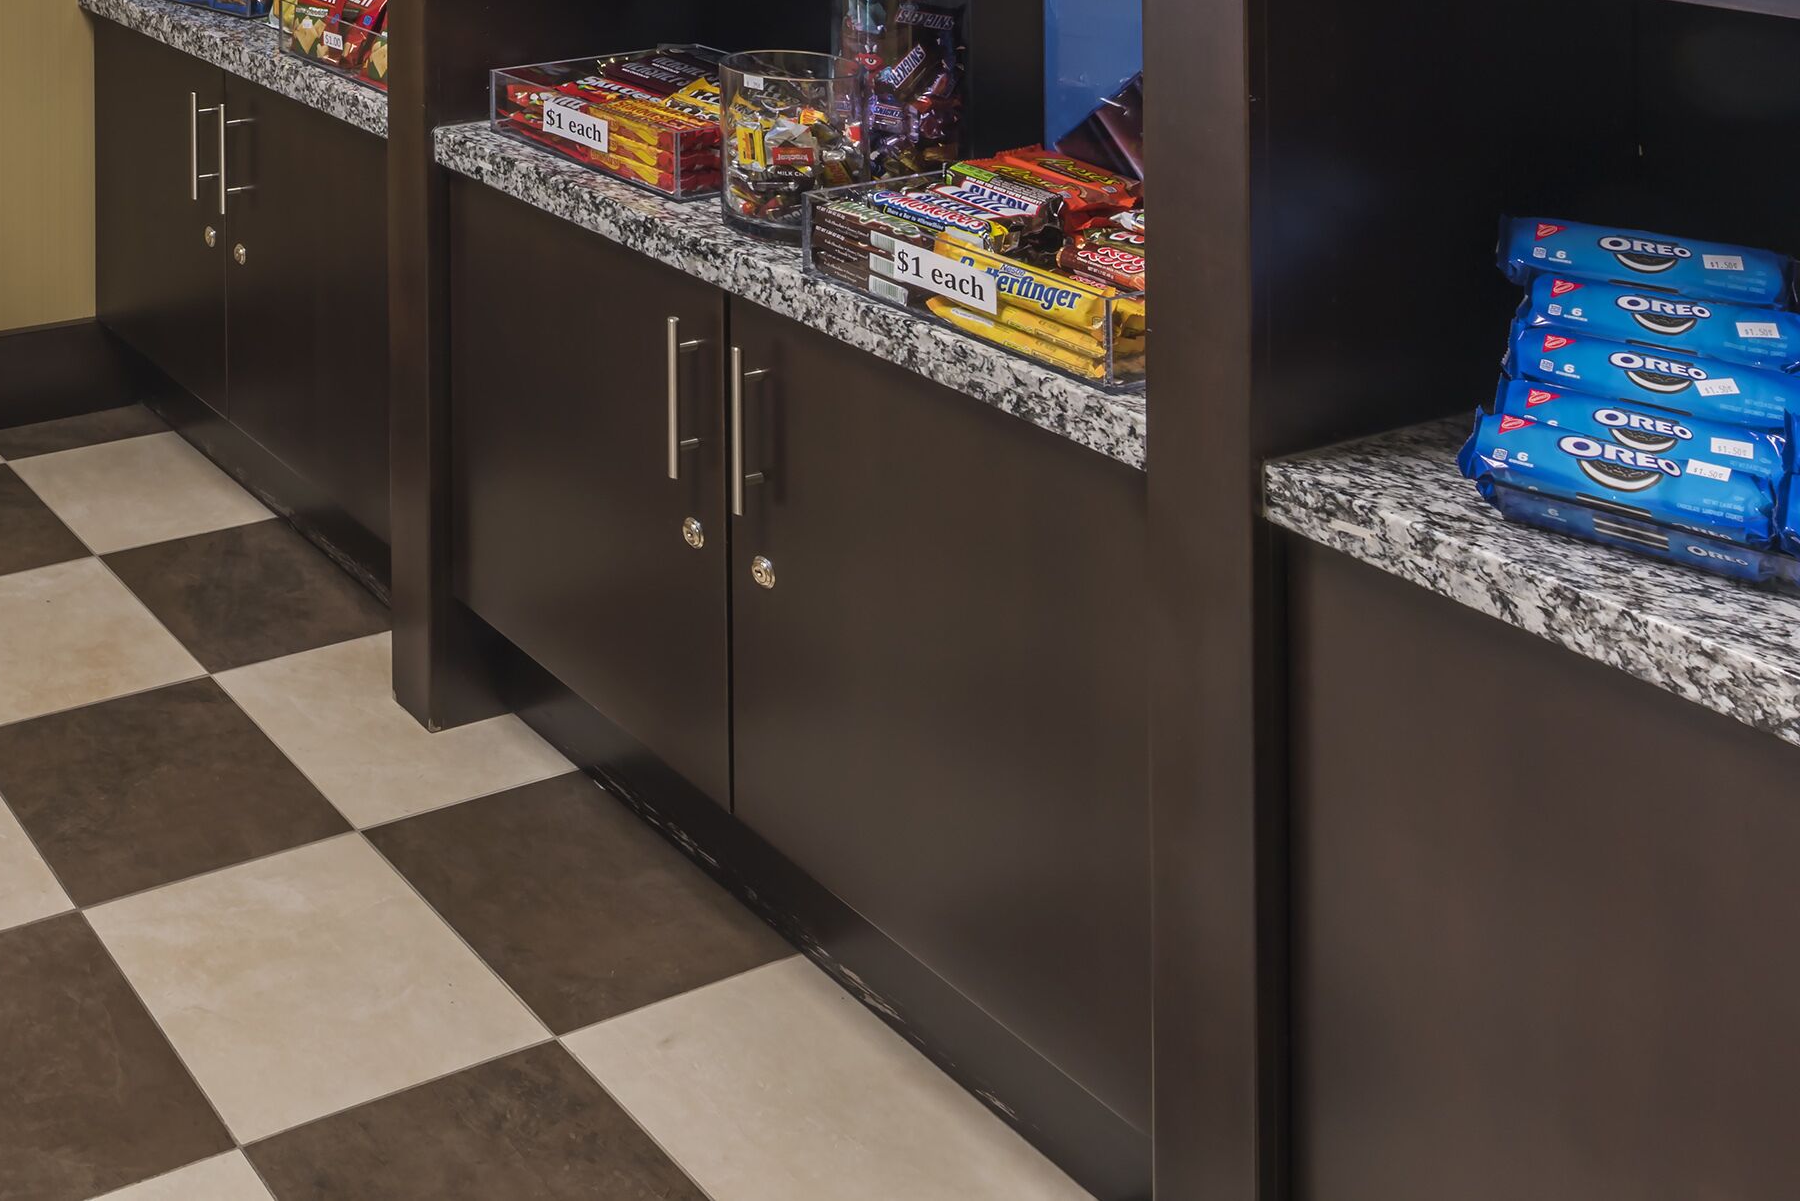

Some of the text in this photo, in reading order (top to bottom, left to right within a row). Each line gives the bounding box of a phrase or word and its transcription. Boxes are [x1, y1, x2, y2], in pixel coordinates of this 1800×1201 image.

[897, 9, 954, 31] SNICKERS
[325, 32, 342, 48] $1.00
[545, 108, 602, 144] $1 each
[886, 207, 899, 217] Share
[903, 211, 911, 219] Bar
[1556, 250, 1567, 259] 6
[1598, 235, 1693, 259] OREO
[896, 249, 985, 303] $1 each
[1571, 307, 1582, 317] 6
[1615, 294, 1712, 319] OREO
[1563, 363, 1575, 374] 6
[1608, 350, 1708, 381] OREO
[1593, 408, 1694, 441] OREO
[1517, 451, 1529, 462] 6
[1557, 435, 1683, 478] OREO
[1687, 545, 1749, 566] OREO
